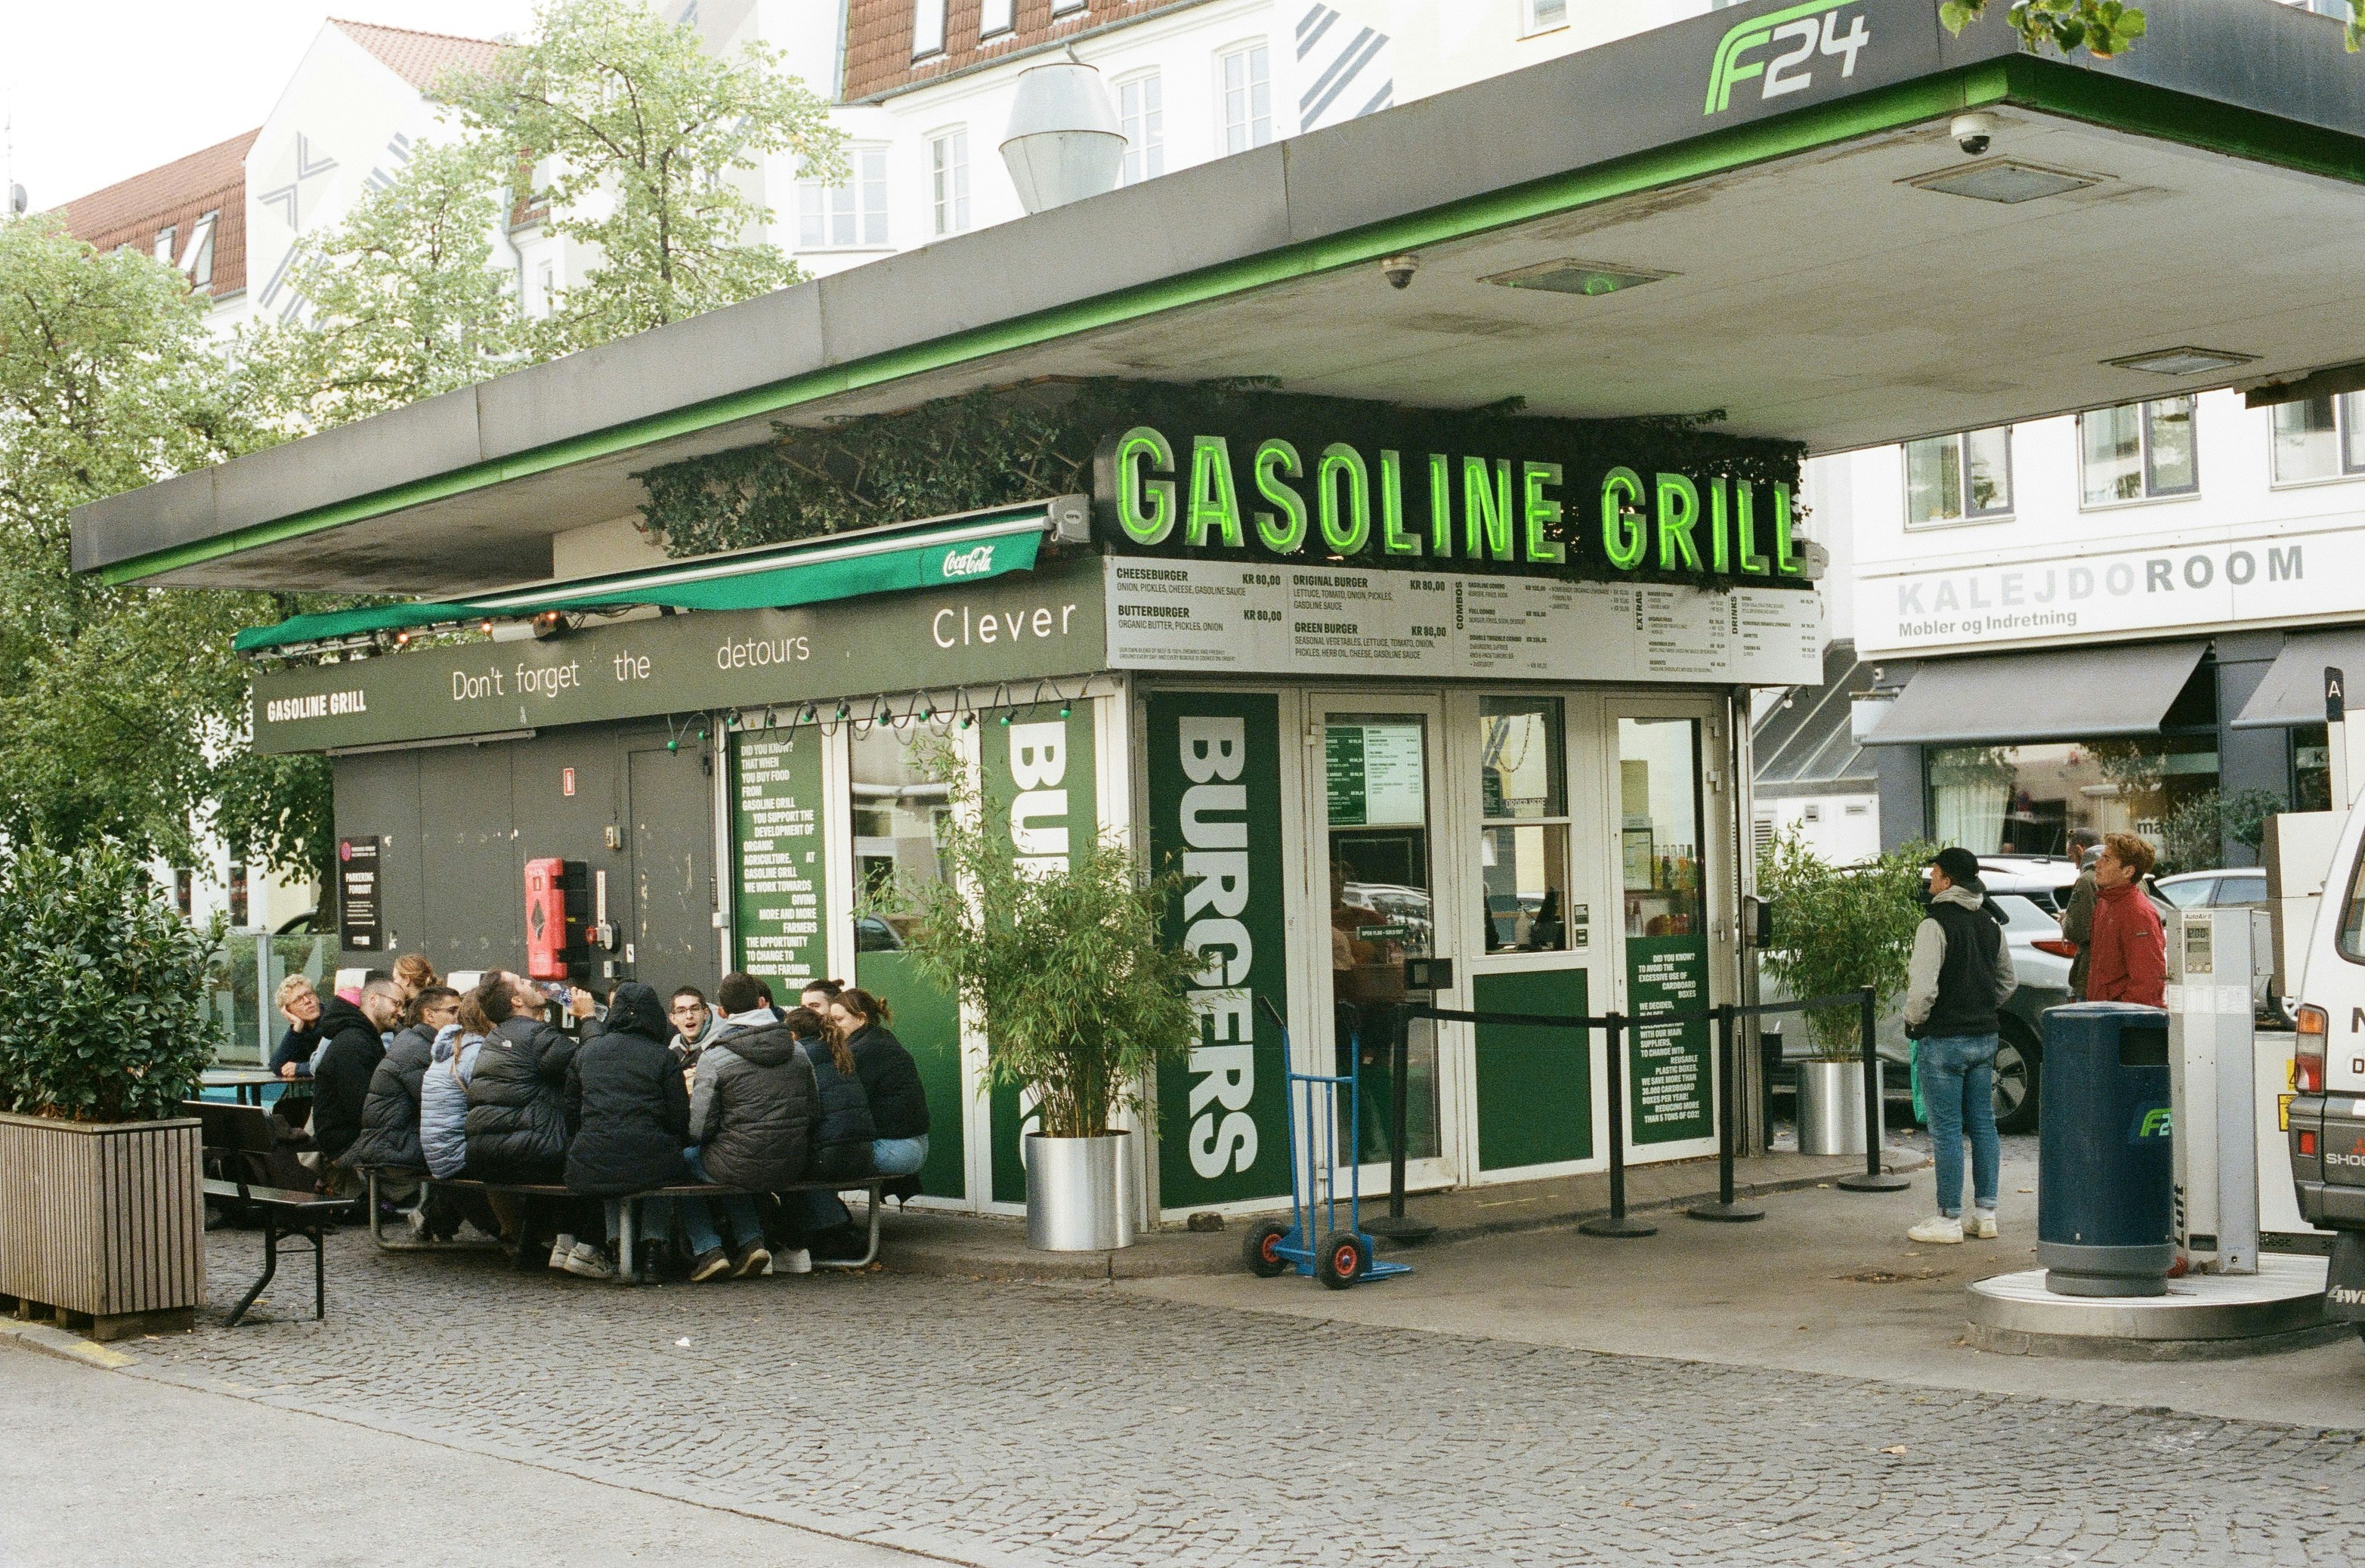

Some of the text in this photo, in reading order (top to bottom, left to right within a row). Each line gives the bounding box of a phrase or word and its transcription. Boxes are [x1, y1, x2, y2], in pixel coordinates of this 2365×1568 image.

[1704, 11, 1869, 116] F24
[1115, 425, 1808, 580] GASOLINE GRILL
[942, 546, 995, 577] Coca-Cola
[1117, 568, 1281, 587] CHEESEBURGER KR 80,00
[1293, 574, 1445, 592] ORIGINAL BURGER KR 80,00
[1898, 546, 2304, 616] KALEJDOROOM
[1118, 583, 1246, 596] ONION, PICKLES, CHEESE, GASOLINE SAUCE
[1294, 601, 1342, 611] GASOLINE SAUCE
[1455, 581, 1464, 629] COMBOS
[1635, 591, 1643, 630] EXTRAS
[1118, 605, 1281, 623] BUTTERBURGER KR 80,00
[932, 605, 1076, 648] Clever
[1119, 620, 1147, 629] ORGANIC
[1148, 620, 1174, 631] BUTTER,
[1203, 623, 1223, 632] ONION
[1899, 610, 2077, 637] Møbler og Indretning
[1294, 622, 1446, 639] GREEN BURGER KR 80,00
[1295, 636, 1325, 645] SEASONAL
[1322, 649, 1337, 657] HERB
[1374, 651, 1402, 659] GASOLINE
[453, 636, 809, 700] Don't forget the detours
[2328, 681, 2341, 697] A
[267, 690, 366, 722] GASOLINE GRILL
[741, 741, 793, 756] DID YOU KNOW?
[742, 757, 779, 770] THAT WHEN
[742, 770, 790, 783] YOU BUY FOOD
[742, 785, 762, 797] FROM
[743, 797, 796, 811] GASOLINE GRILL
[753, 810, 814, 824] YOU SUPPORT THE
[755, 824, 815, 837] DEVELOPMENT OF
[744, 840, 774, 852] ORGANIC
[744, 852, 815, 865] AGRICULTURE. AT
[744, 867, 797, 880] GASOLINE GRILL
[744, 880, 812, 893] WE WORK TOWARDS
[792, 894, 816, 905] GIVING
[759, 908, 817, 920] MORE AND MORE
[783, 922, 818, 933] FARMERS
[746, 936, 808, 948] THE OPPORTUNITY
[1178, 716, 1258, 1180] BURGERS
[746, 950, 793, 961] TO CHANGE TO
[1653, 953, 1695, 963] DID YOU KNOW?
[747, 964, 810, 975] ORGANIC FARMING
[1646, 964, 1663, 973] AVOID
[1638, 973, 1668, 982] EXCESSIVE
[1662, 981, 1696, 990] CARDBOARD
[1678, 990, 1696, 998] BOXES
[1640, 1030, 1655, 1039] WITH
[1655, 1029, 1667, 1038] OUR
[1641, 1047, 1684, 1058] TO CHANGE INTO
[1671, 1055, 1699, 1064] REUSABLE
[1656, 1065, 1678, 1075] PLASTIC
[1641, 1073, 1697, 1086] WE SAVE MORE THAN
[1661, 1083, 1695, 1093] CARDBOARD
[1642, 1096, 1660, 1105] BOXES
[1662, 1094, 1672, 1103] PER
[1656, 1101, 1699, 1112] REDUCING MORE
[1644, 1115, 1659, 1124] THAN
[1665, 1112, 1679, 1121] TONS
[2140, 1108, 2173, 1137] F2
